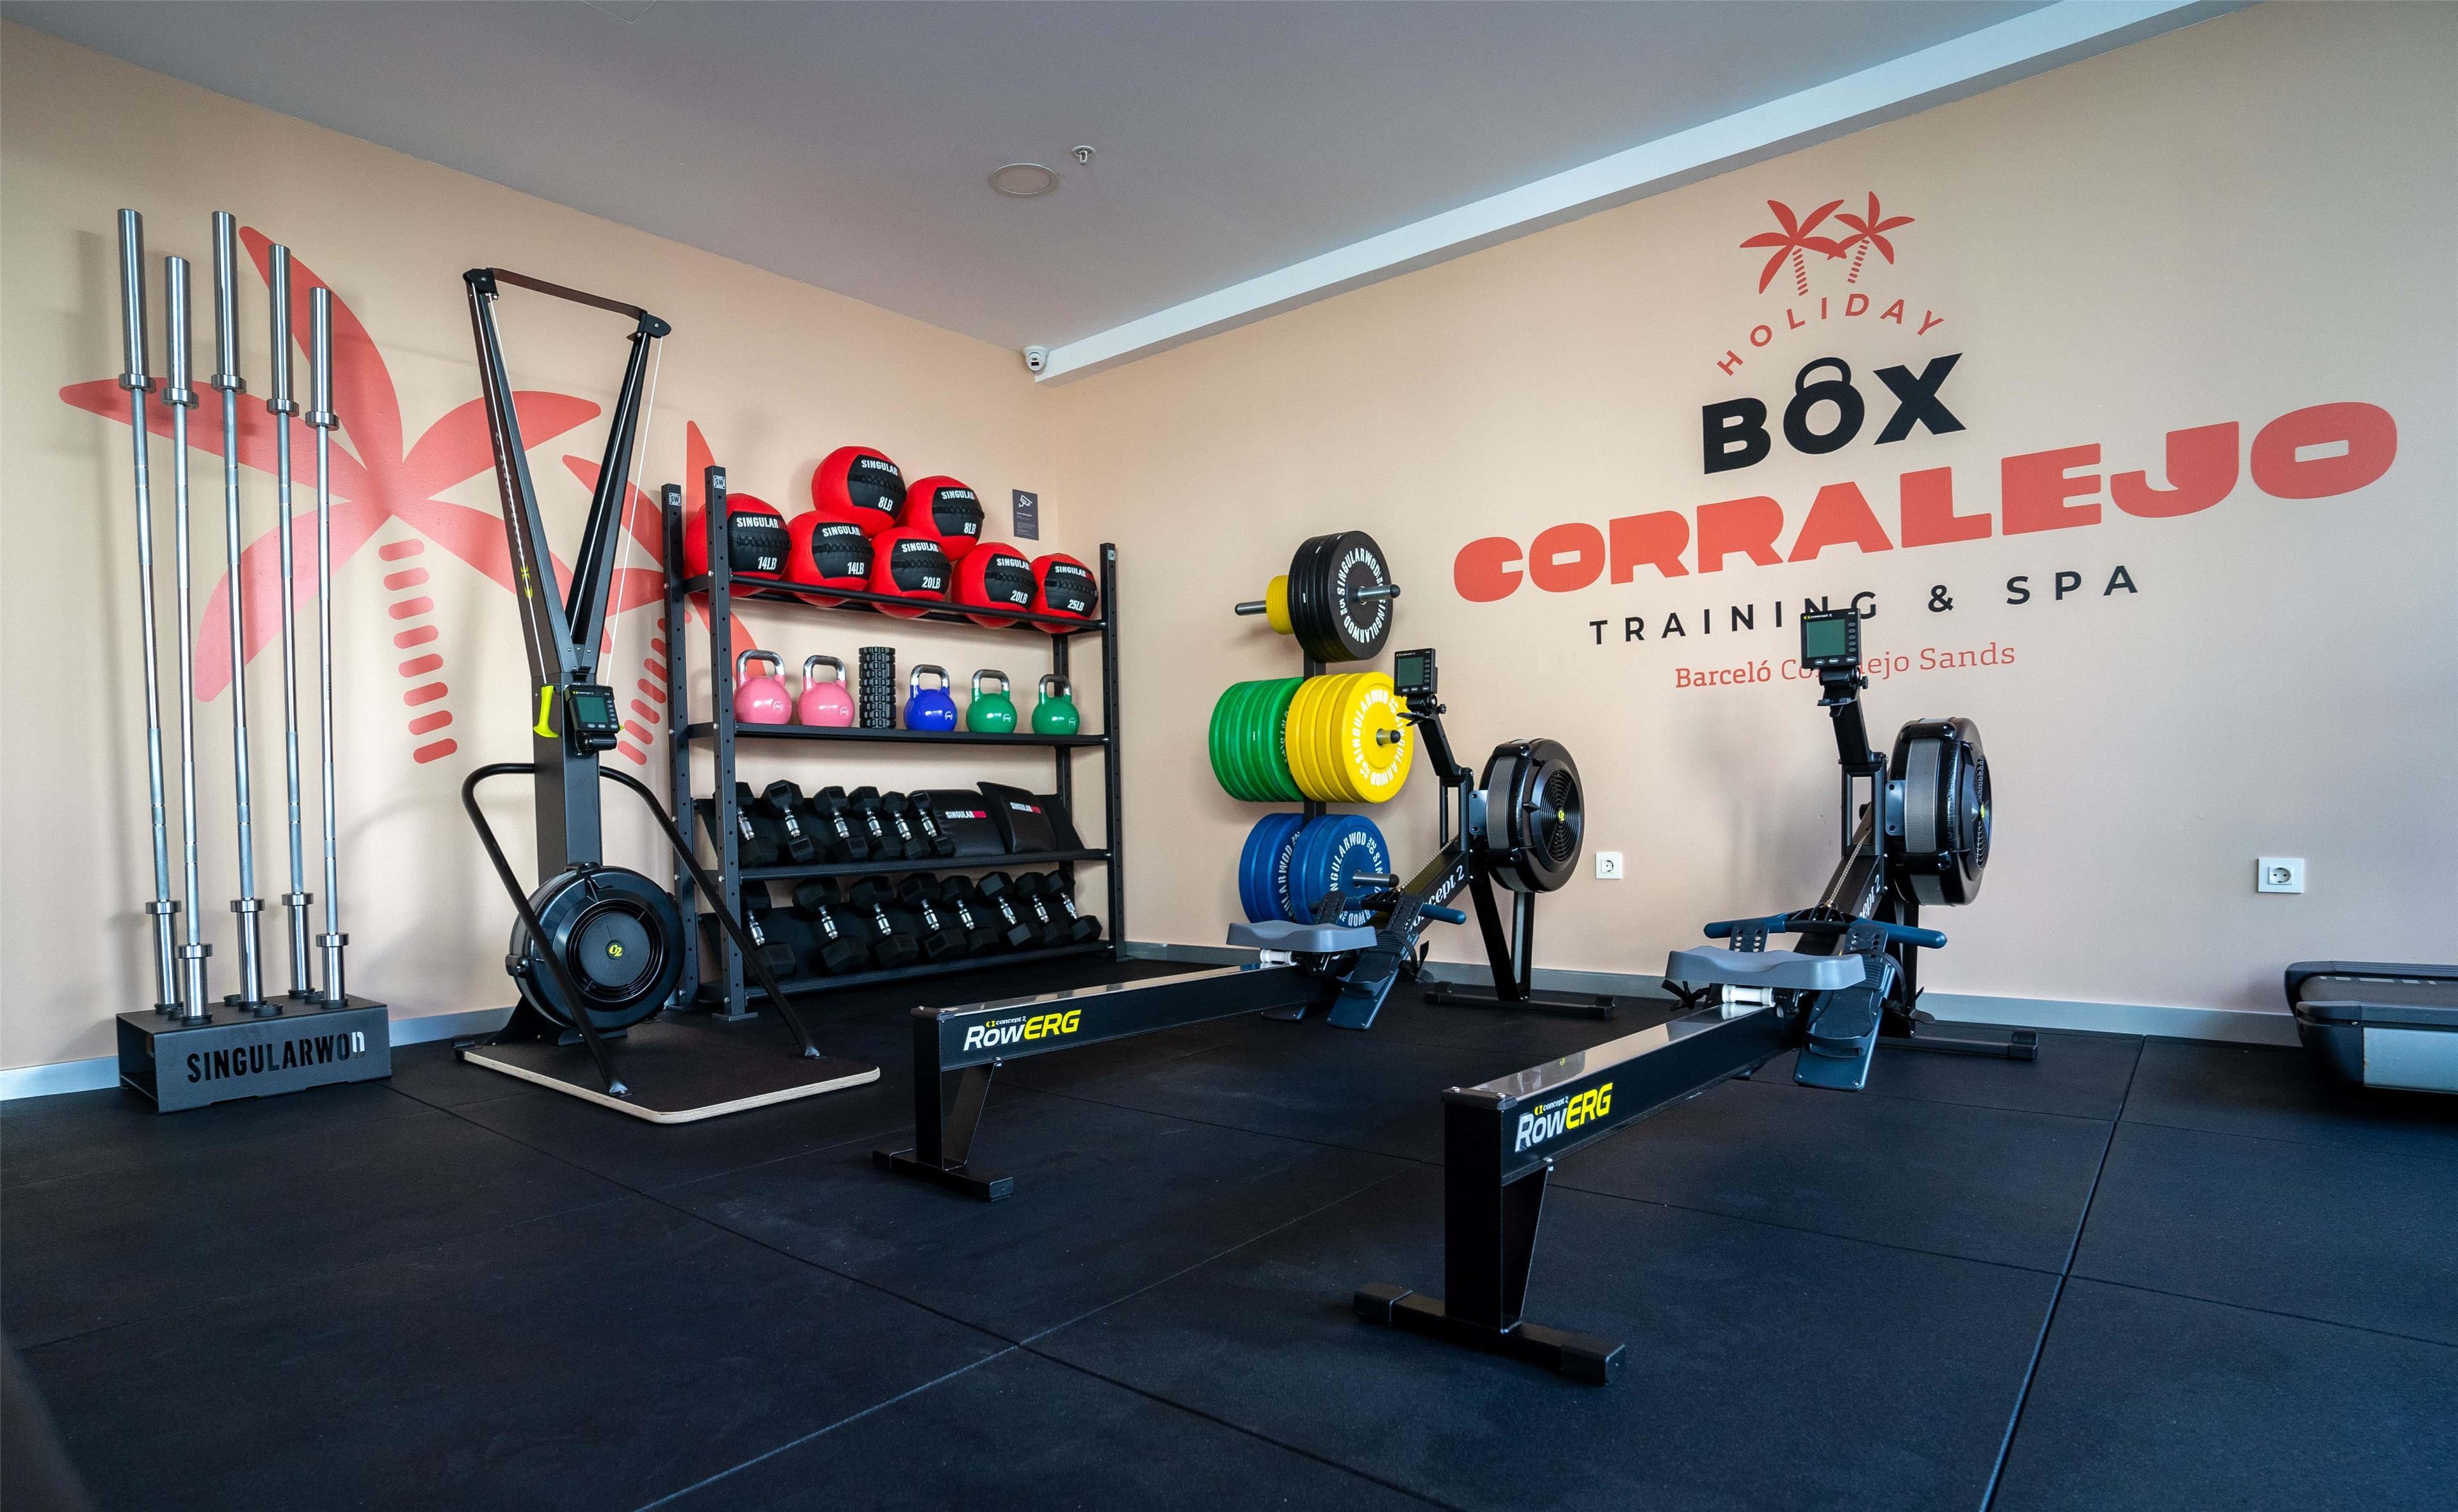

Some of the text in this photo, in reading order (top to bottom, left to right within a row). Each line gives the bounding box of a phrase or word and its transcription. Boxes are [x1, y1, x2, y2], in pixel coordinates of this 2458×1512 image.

[1717, 293, 1945, 376] HOLIDAY
[1702, 353, 1966, 474] BOX
[878, 496, 893, 511] 8LB
[1454, 401, 2397, 603] CORRALEJO
[965, 522, 976, 535] 8LB
[758, 556, 777, 570] 14LB
[847, 563, 864, 575] 14LB
[1337, 548, 1381, 595] SINGULARWOD
[922, 576, 940, 590] 20LB
[1010, 590, 1028, 604] 20LB
[1067, 600, 1085, 611] 25LB
[1589, 565, 2138, 645] TRAINING & SPA
[1675, 659, 1771, 688] Barceló
[1920, 642, 2015, 670] Sands
[995, 1017, 1022, 1025] concept
